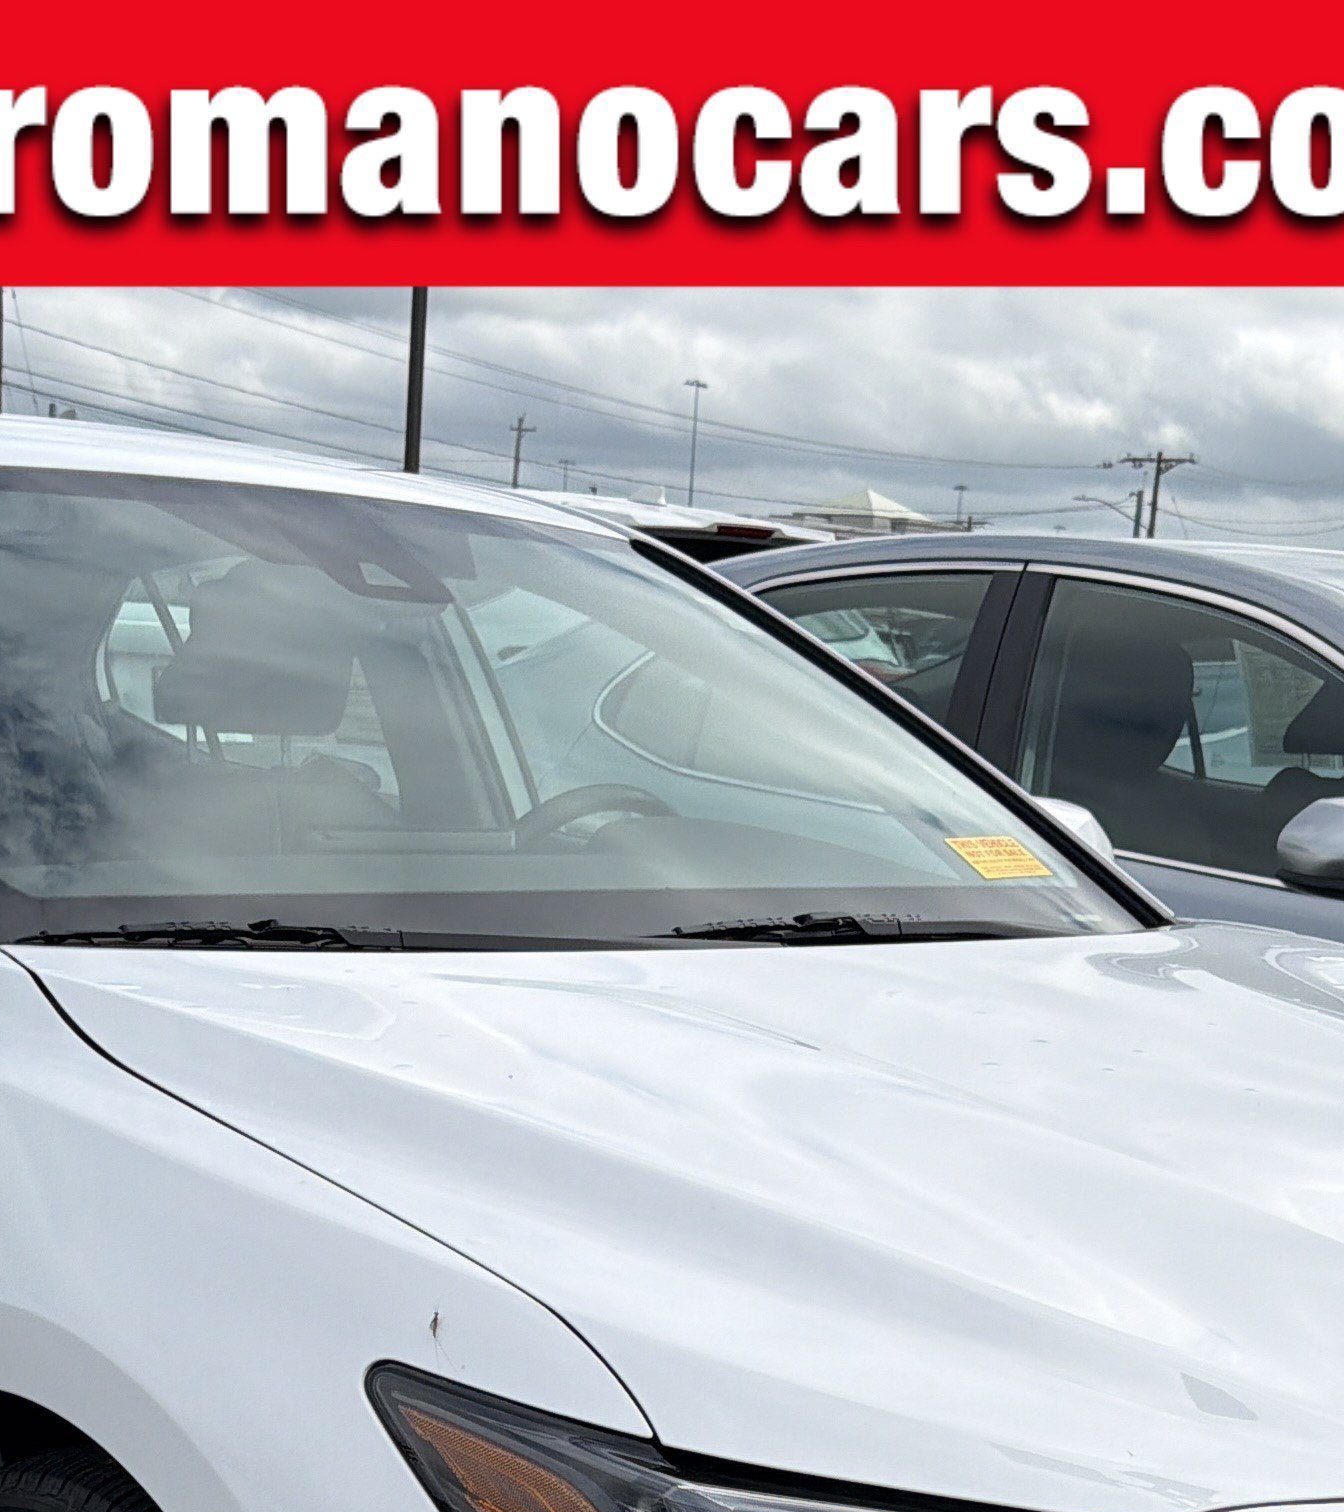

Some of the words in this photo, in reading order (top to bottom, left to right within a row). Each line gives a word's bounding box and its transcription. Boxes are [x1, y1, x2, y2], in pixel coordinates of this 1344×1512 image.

[978, 838, 1020, 848] VEHICLE
[986, 849, 1003, 857] FOR
[1004, 848, 1028, 856] SALE
